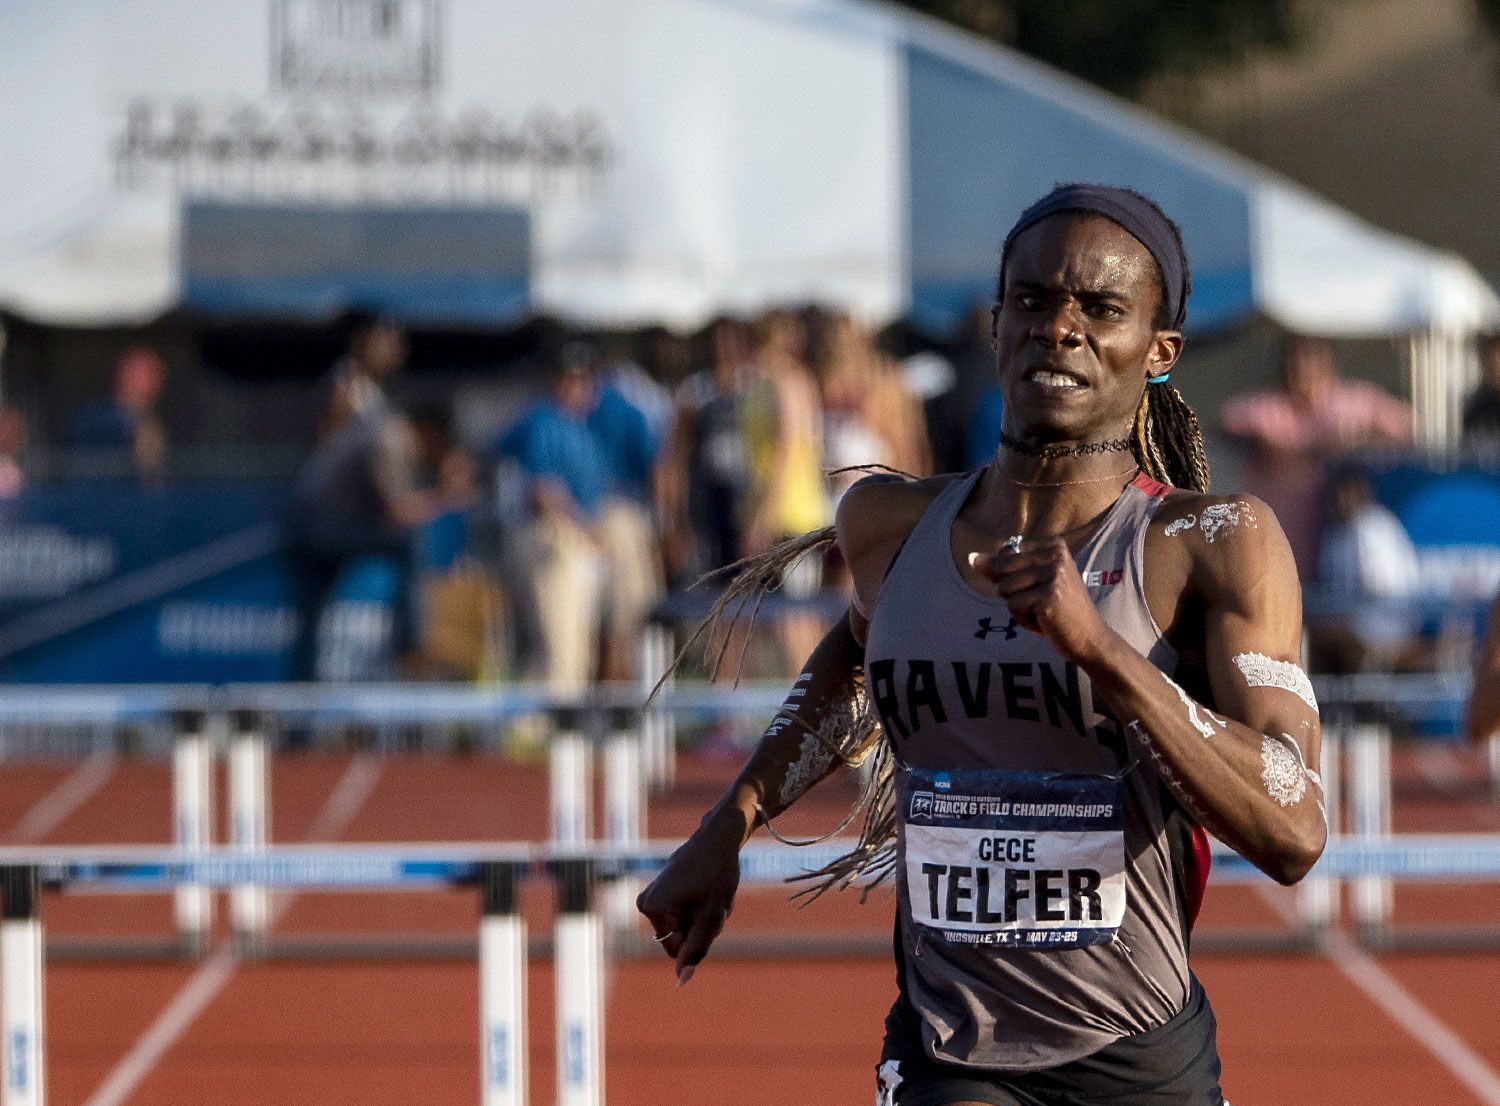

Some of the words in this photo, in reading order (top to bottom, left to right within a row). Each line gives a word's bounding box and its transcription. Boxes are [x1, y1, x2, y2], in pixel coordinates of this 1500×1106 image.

[934, 800, 967, 815] TRACK
[969, 803, 978, 815] &
[979, 804, 1010, 816] FIELD
[1012, 803, 1113, 818] CHAMPIONSHIPS
[978, 837, 1035, 862] CECE
[922, 862, 1103, 923] TELFER
[996, 932, 1009, 943] TX
[1026, 931, 1046, 943] MAY
[1049, 931, 1079, 942] 23-25
